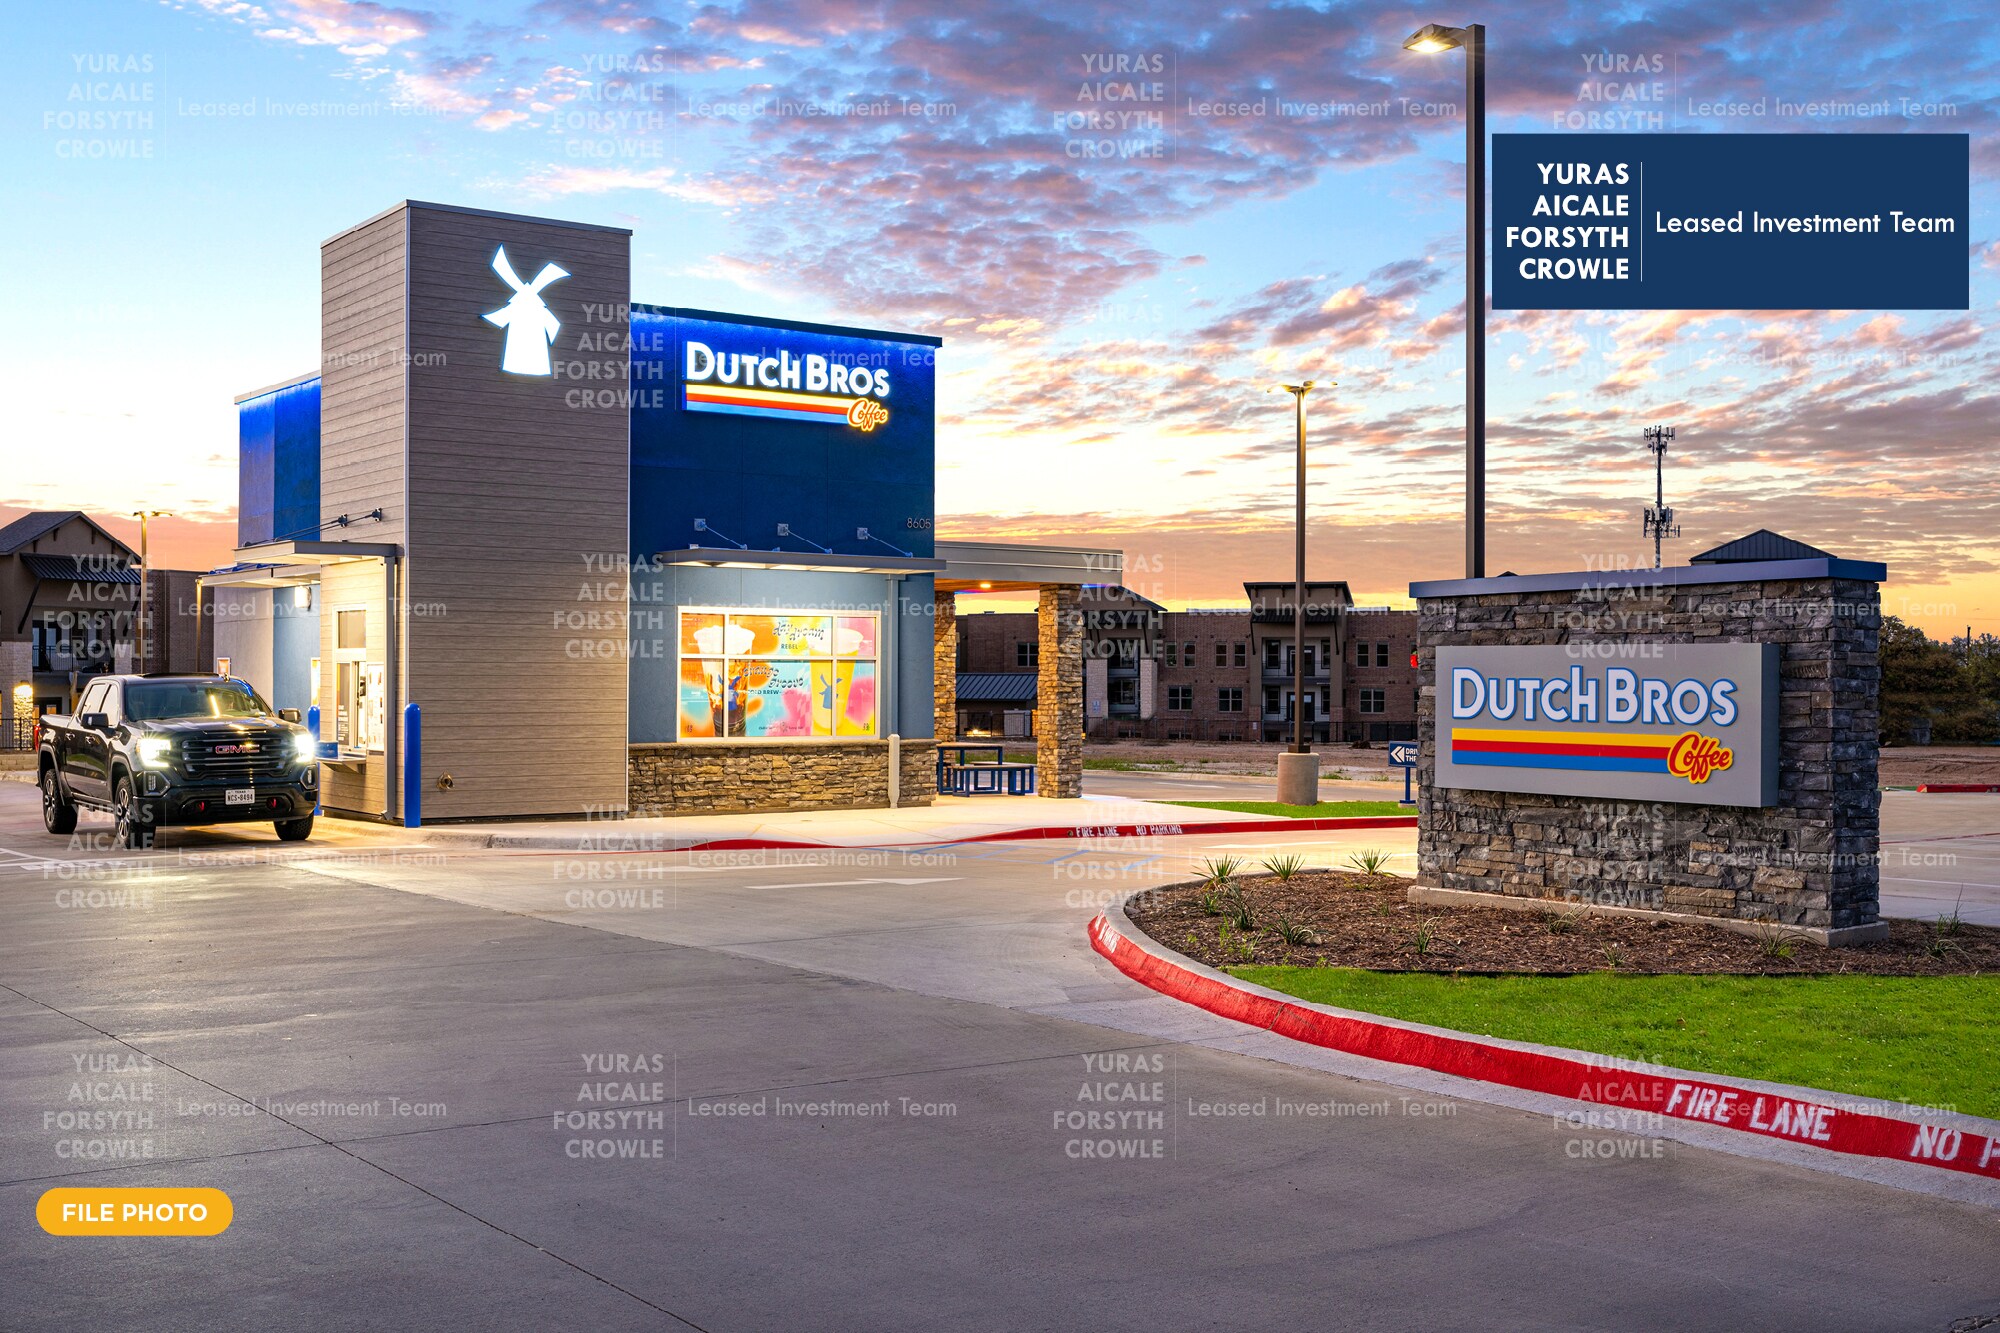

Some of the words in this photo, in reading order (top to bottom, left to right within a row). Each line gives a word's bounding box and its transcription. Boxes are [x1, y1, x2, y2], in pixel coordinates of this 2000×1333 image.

[849, 399, 888, 431] Coffee
[906, 518, 932, 528] 8605
[215, 744, 260, 754] GMC
[1668, 733, 1731, 782] Coffee
[1076, 827, 1094, 837] FIRE
[1098, 826, 1120, 837] LANE
[1136, 825, 1147, 836] NO
[1150, 824, 1182, 834] PARKING
[1666, 1084, 1739, 1123] FIRE
[1748, 1096, 1836, 1142] LANE
[1910, 1124, 1962, 1161] NO
